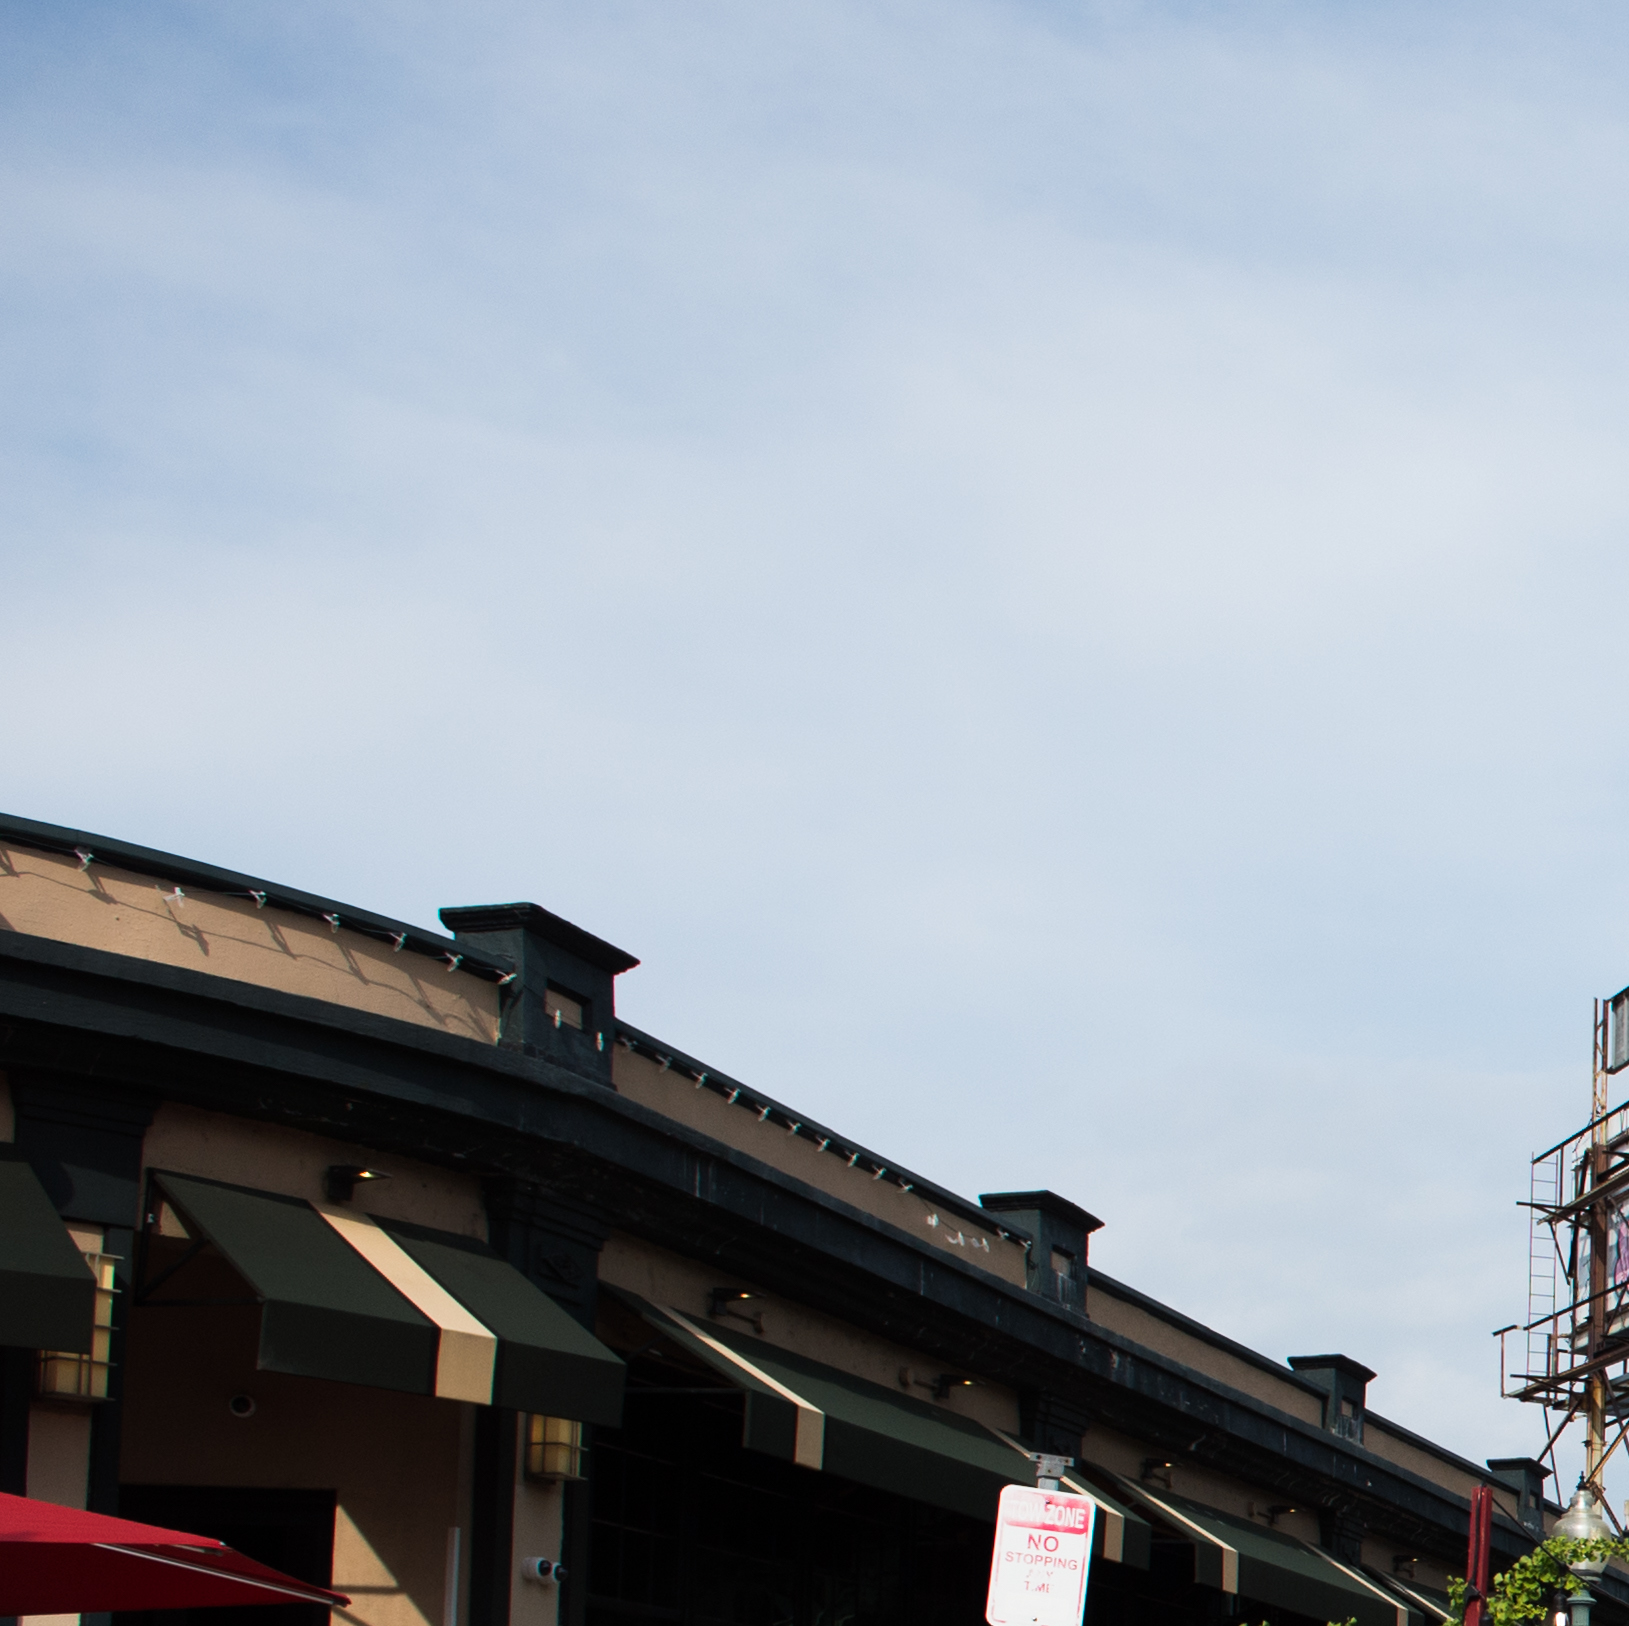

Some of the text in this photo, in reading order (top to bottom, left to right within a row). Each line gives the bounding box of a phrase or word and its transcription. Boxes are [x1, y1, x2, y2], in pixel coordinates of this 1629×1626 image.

[1043, 1504, 1086, 1530] ZONE
[1027, 1533, 1060, 1553] NO
[1005, 1551, 1078, 1571] STOPPING
